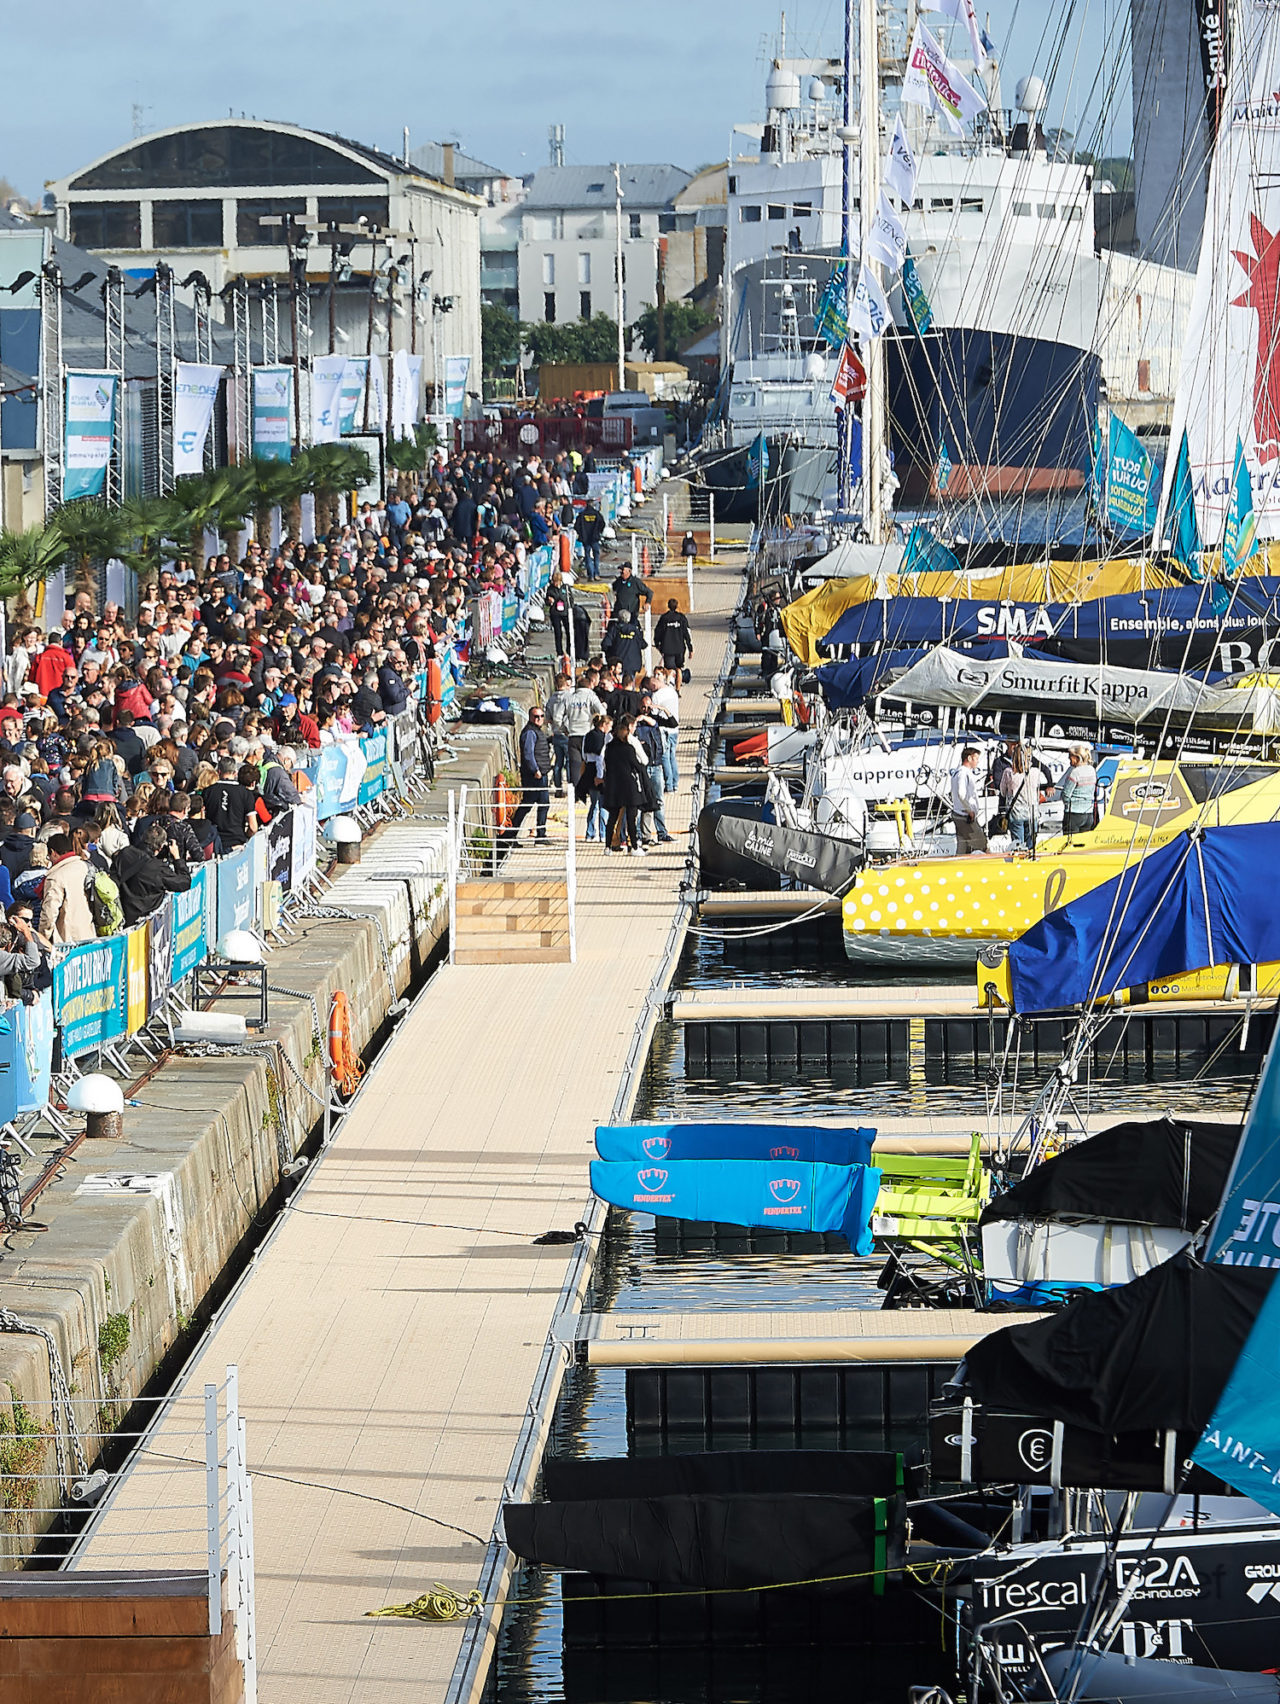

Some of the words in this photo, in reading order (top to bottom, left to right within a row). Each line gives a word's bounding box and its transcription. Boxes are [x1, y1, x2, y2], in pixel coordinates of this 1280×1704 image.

[977, 605, 1054, 636] SMA
[1110, 617, 1184, 632] Ensemble,
[1001, 670, 1080, 694] Smurfit
[1081, 676, 1148, 703] Kappa
[1116, 1556, 1200, 1589] B2A
[974, 1572, 1087, 1608] Trescal
